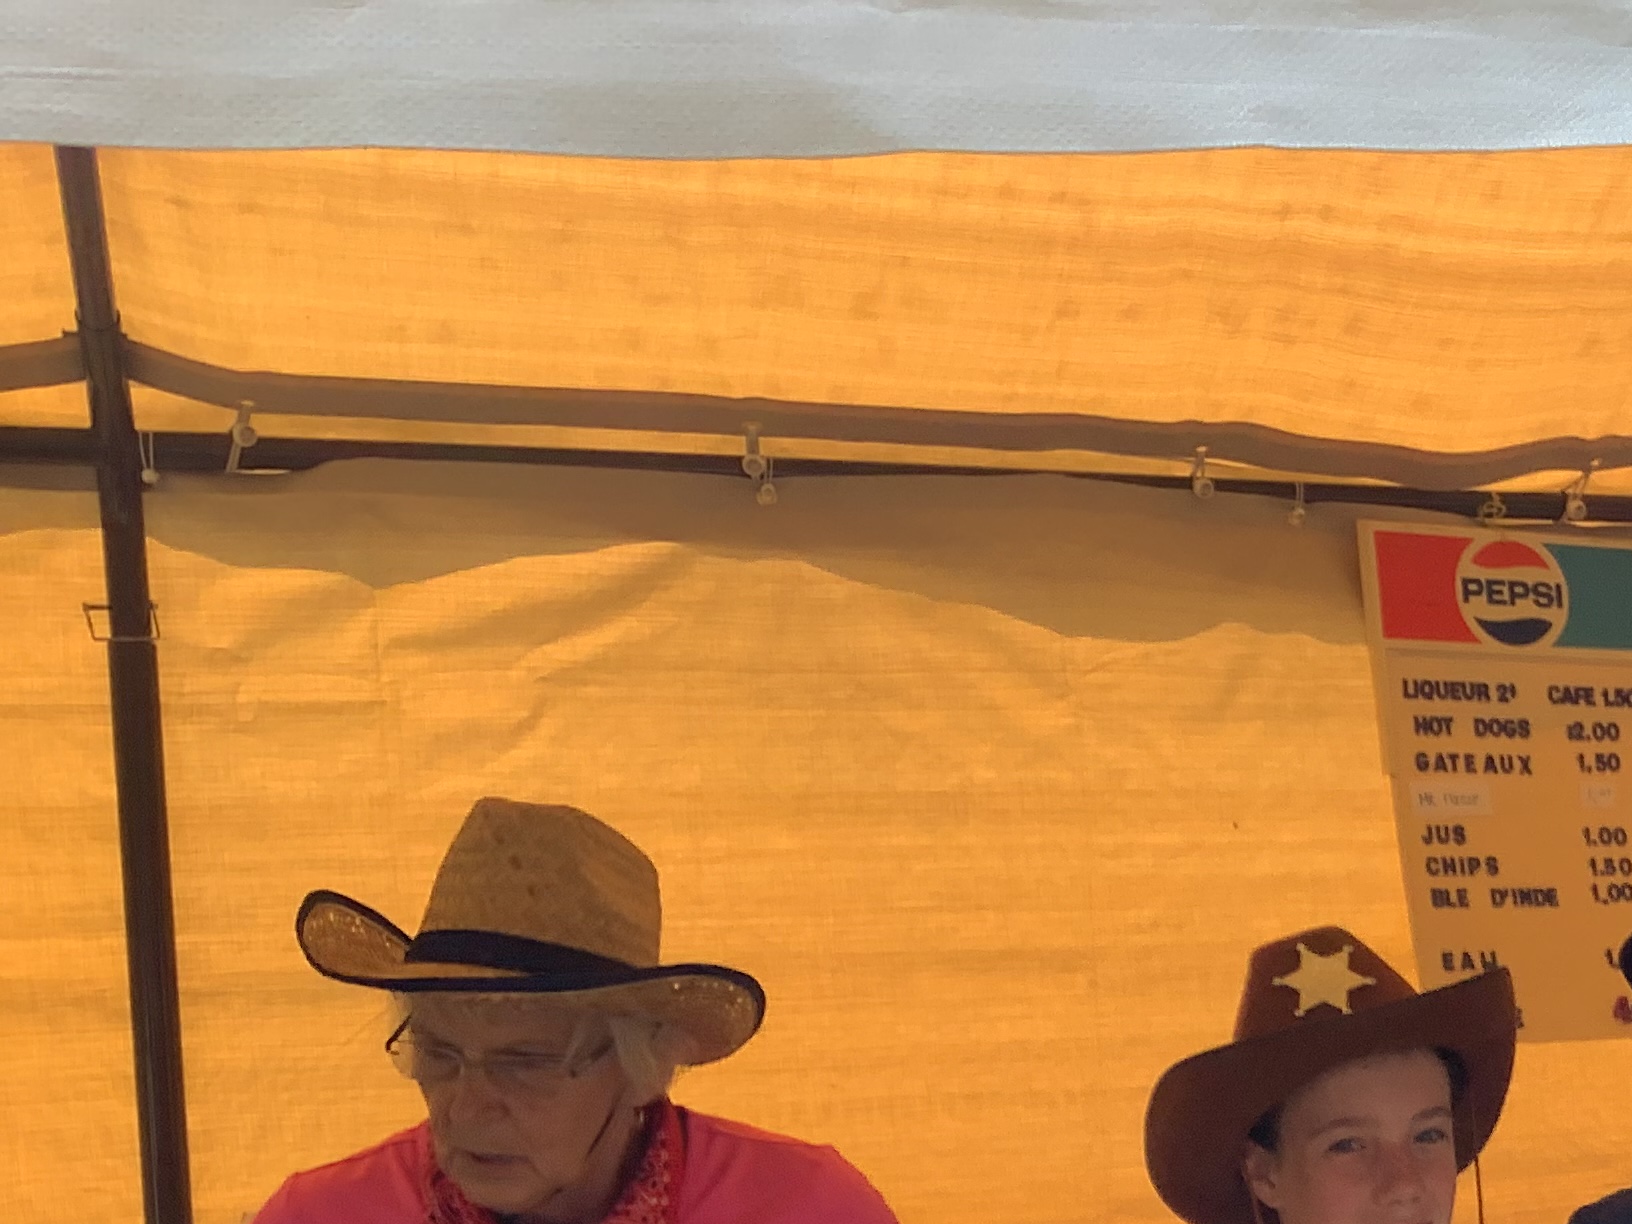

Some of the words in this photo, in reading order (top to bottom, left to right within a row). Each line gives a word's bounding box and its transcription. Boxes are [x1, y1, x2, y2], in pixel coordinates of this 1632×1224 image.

[1461, 576, 1563, 609] PEPSI
[1402, 678, 1490, 702] LIQUEUR
[1547, 685, 1596, 707] CAFE
[1413, 716, 1453, 737] HOT
[1473, 717, 1530, 739] DOGS
[1415, 752, 1532, 775] GATEAUX
[1421, 824, 1466, 845] JUS
[1425, 856, 1499, 877] CHIPS
